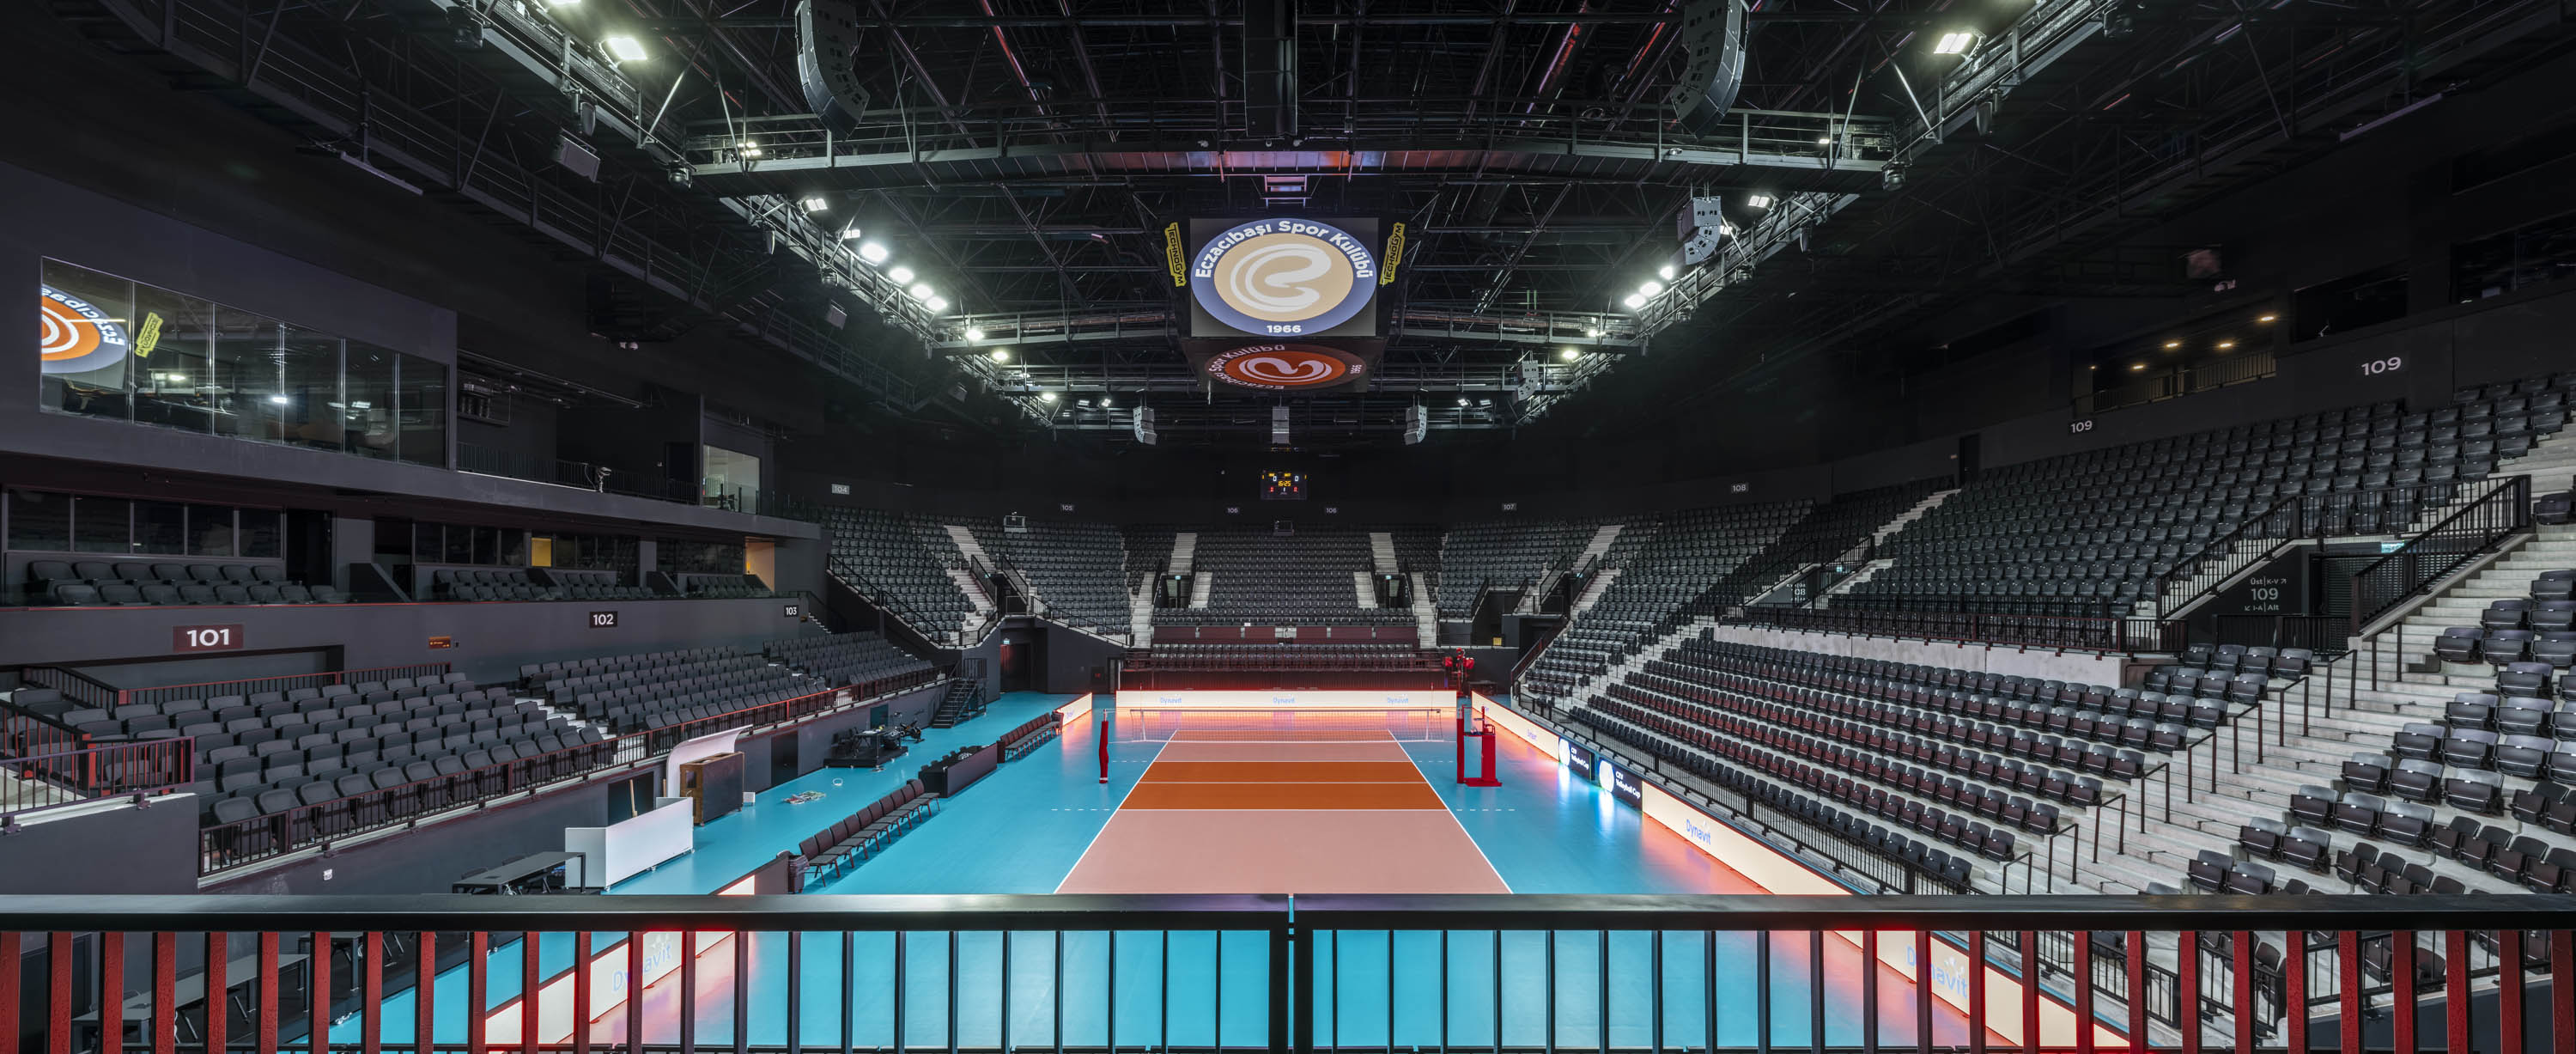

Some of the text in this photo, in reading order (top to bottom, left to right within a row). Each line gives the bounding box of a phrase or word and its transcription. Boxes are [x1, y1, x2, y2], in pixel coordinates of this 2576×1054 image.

[1167, 223, 1184, 284] TECHNOGYM
[1195, 220, 1374, 278] Eczacıbaşı Spor Kulübü
[1383, 224, 1402, 282] TECHNOGYM
[1267, 325, 1302, 333] 1966
[1209, 358, 1227, 372] Spor
[2361, 356, 2402, 375] 109
[2070, 420, 2093, 433] 109
[2251, 588, 2279, 600] 109
[786, 606, 798, 616] 103
[593, 613, 614, 625] 102
[186, 628, 229, 647] 101
[1632, 787, 1641, 800] Cup
[1686, 819, 1711, 846] Dynavit
